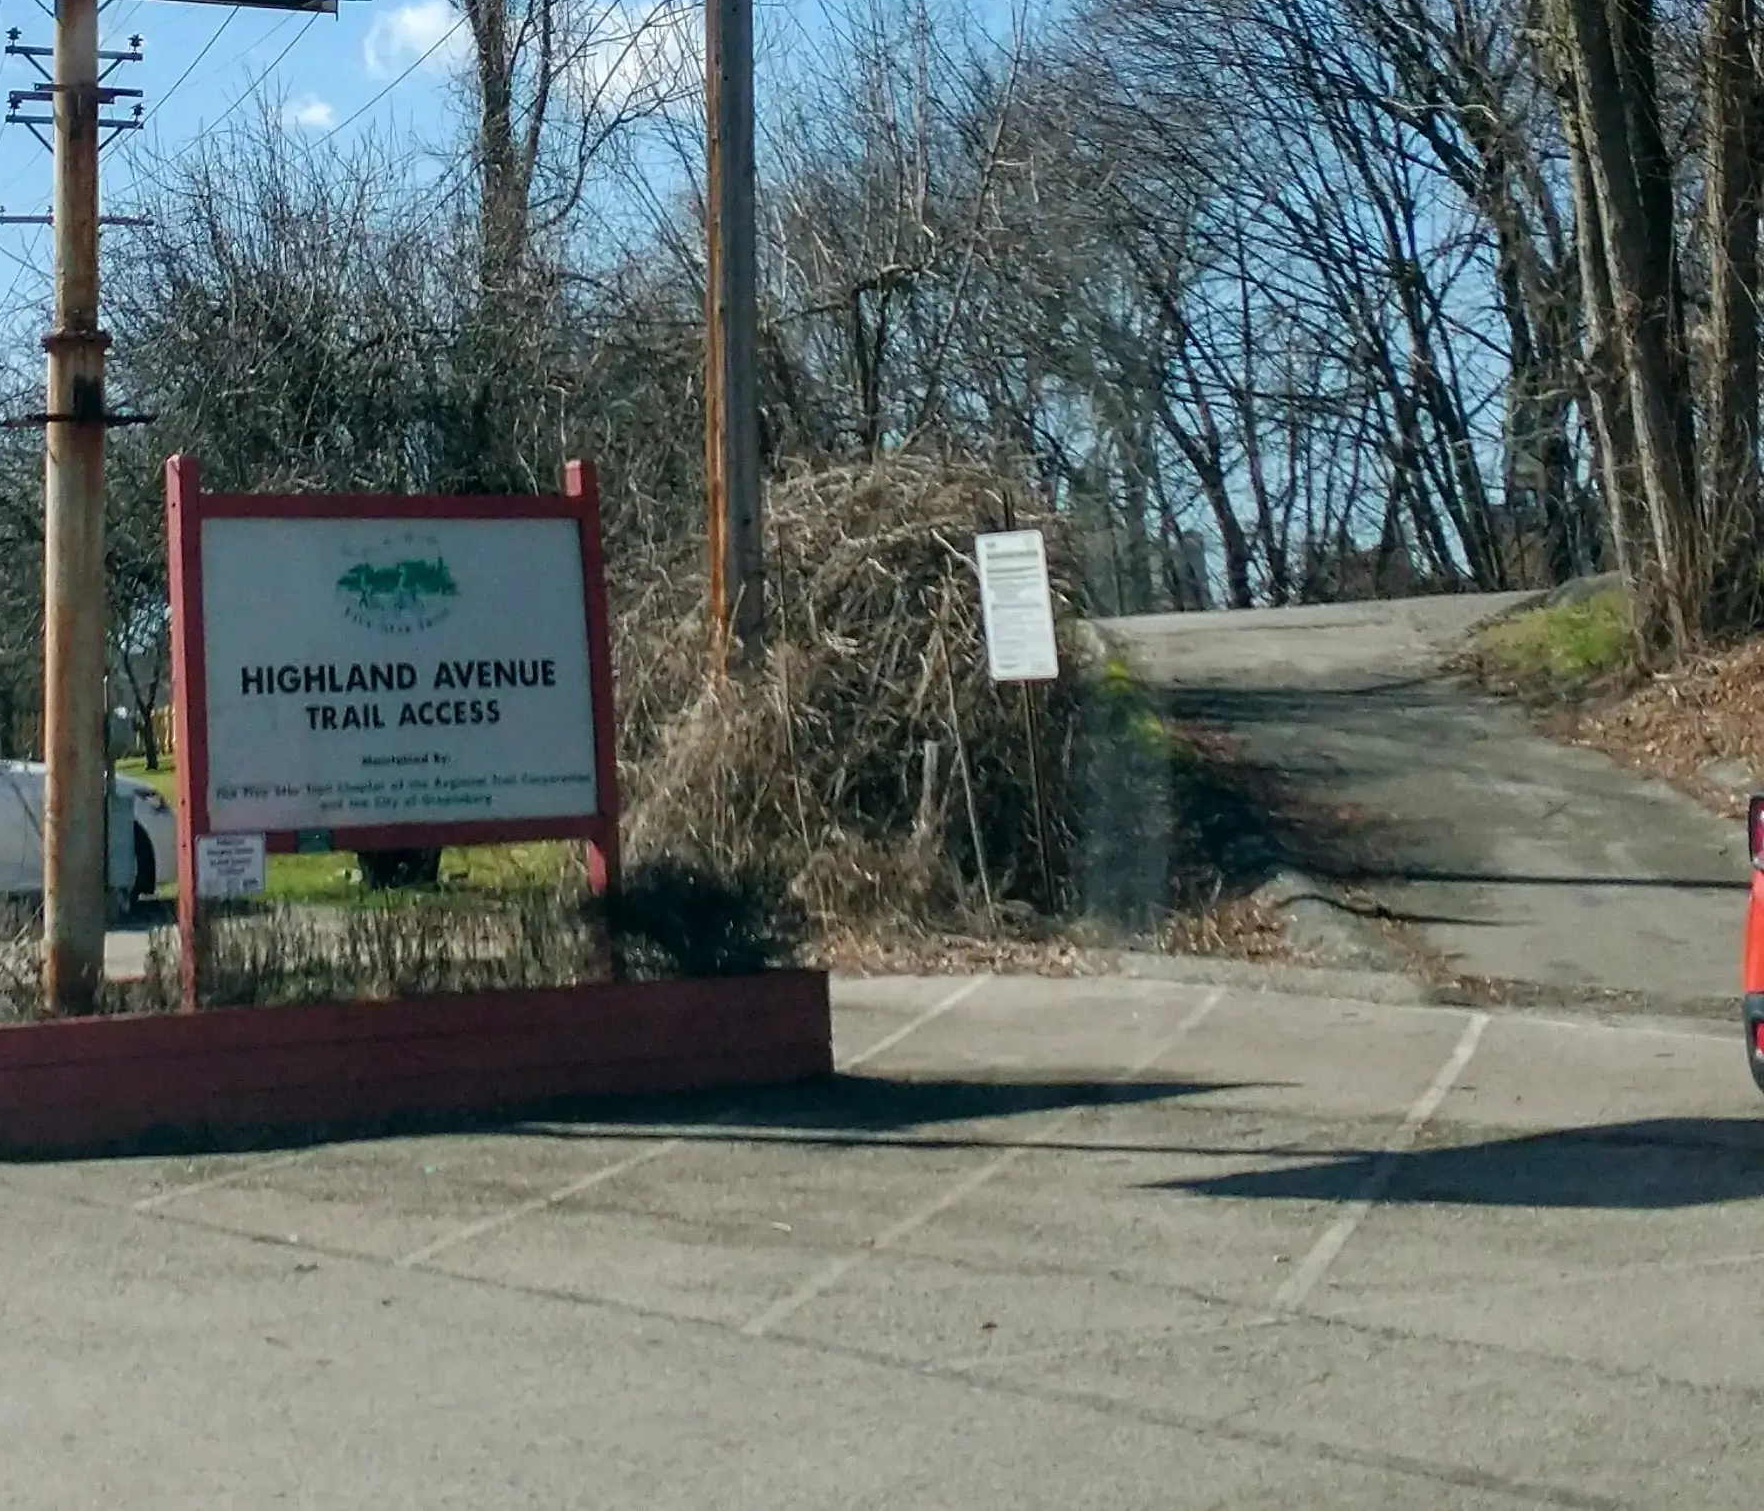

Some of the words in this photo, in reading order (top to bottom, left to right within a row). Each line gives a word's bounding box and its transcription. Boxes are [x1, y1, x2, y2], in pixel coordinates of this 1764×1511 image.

[240, 661, 418, 695] HIGHLAND
[434, 658, 557, 690] AVENUE
[305, 703, 387, 731] TRAIL
[398, 698, 501, 728] ACCESS
